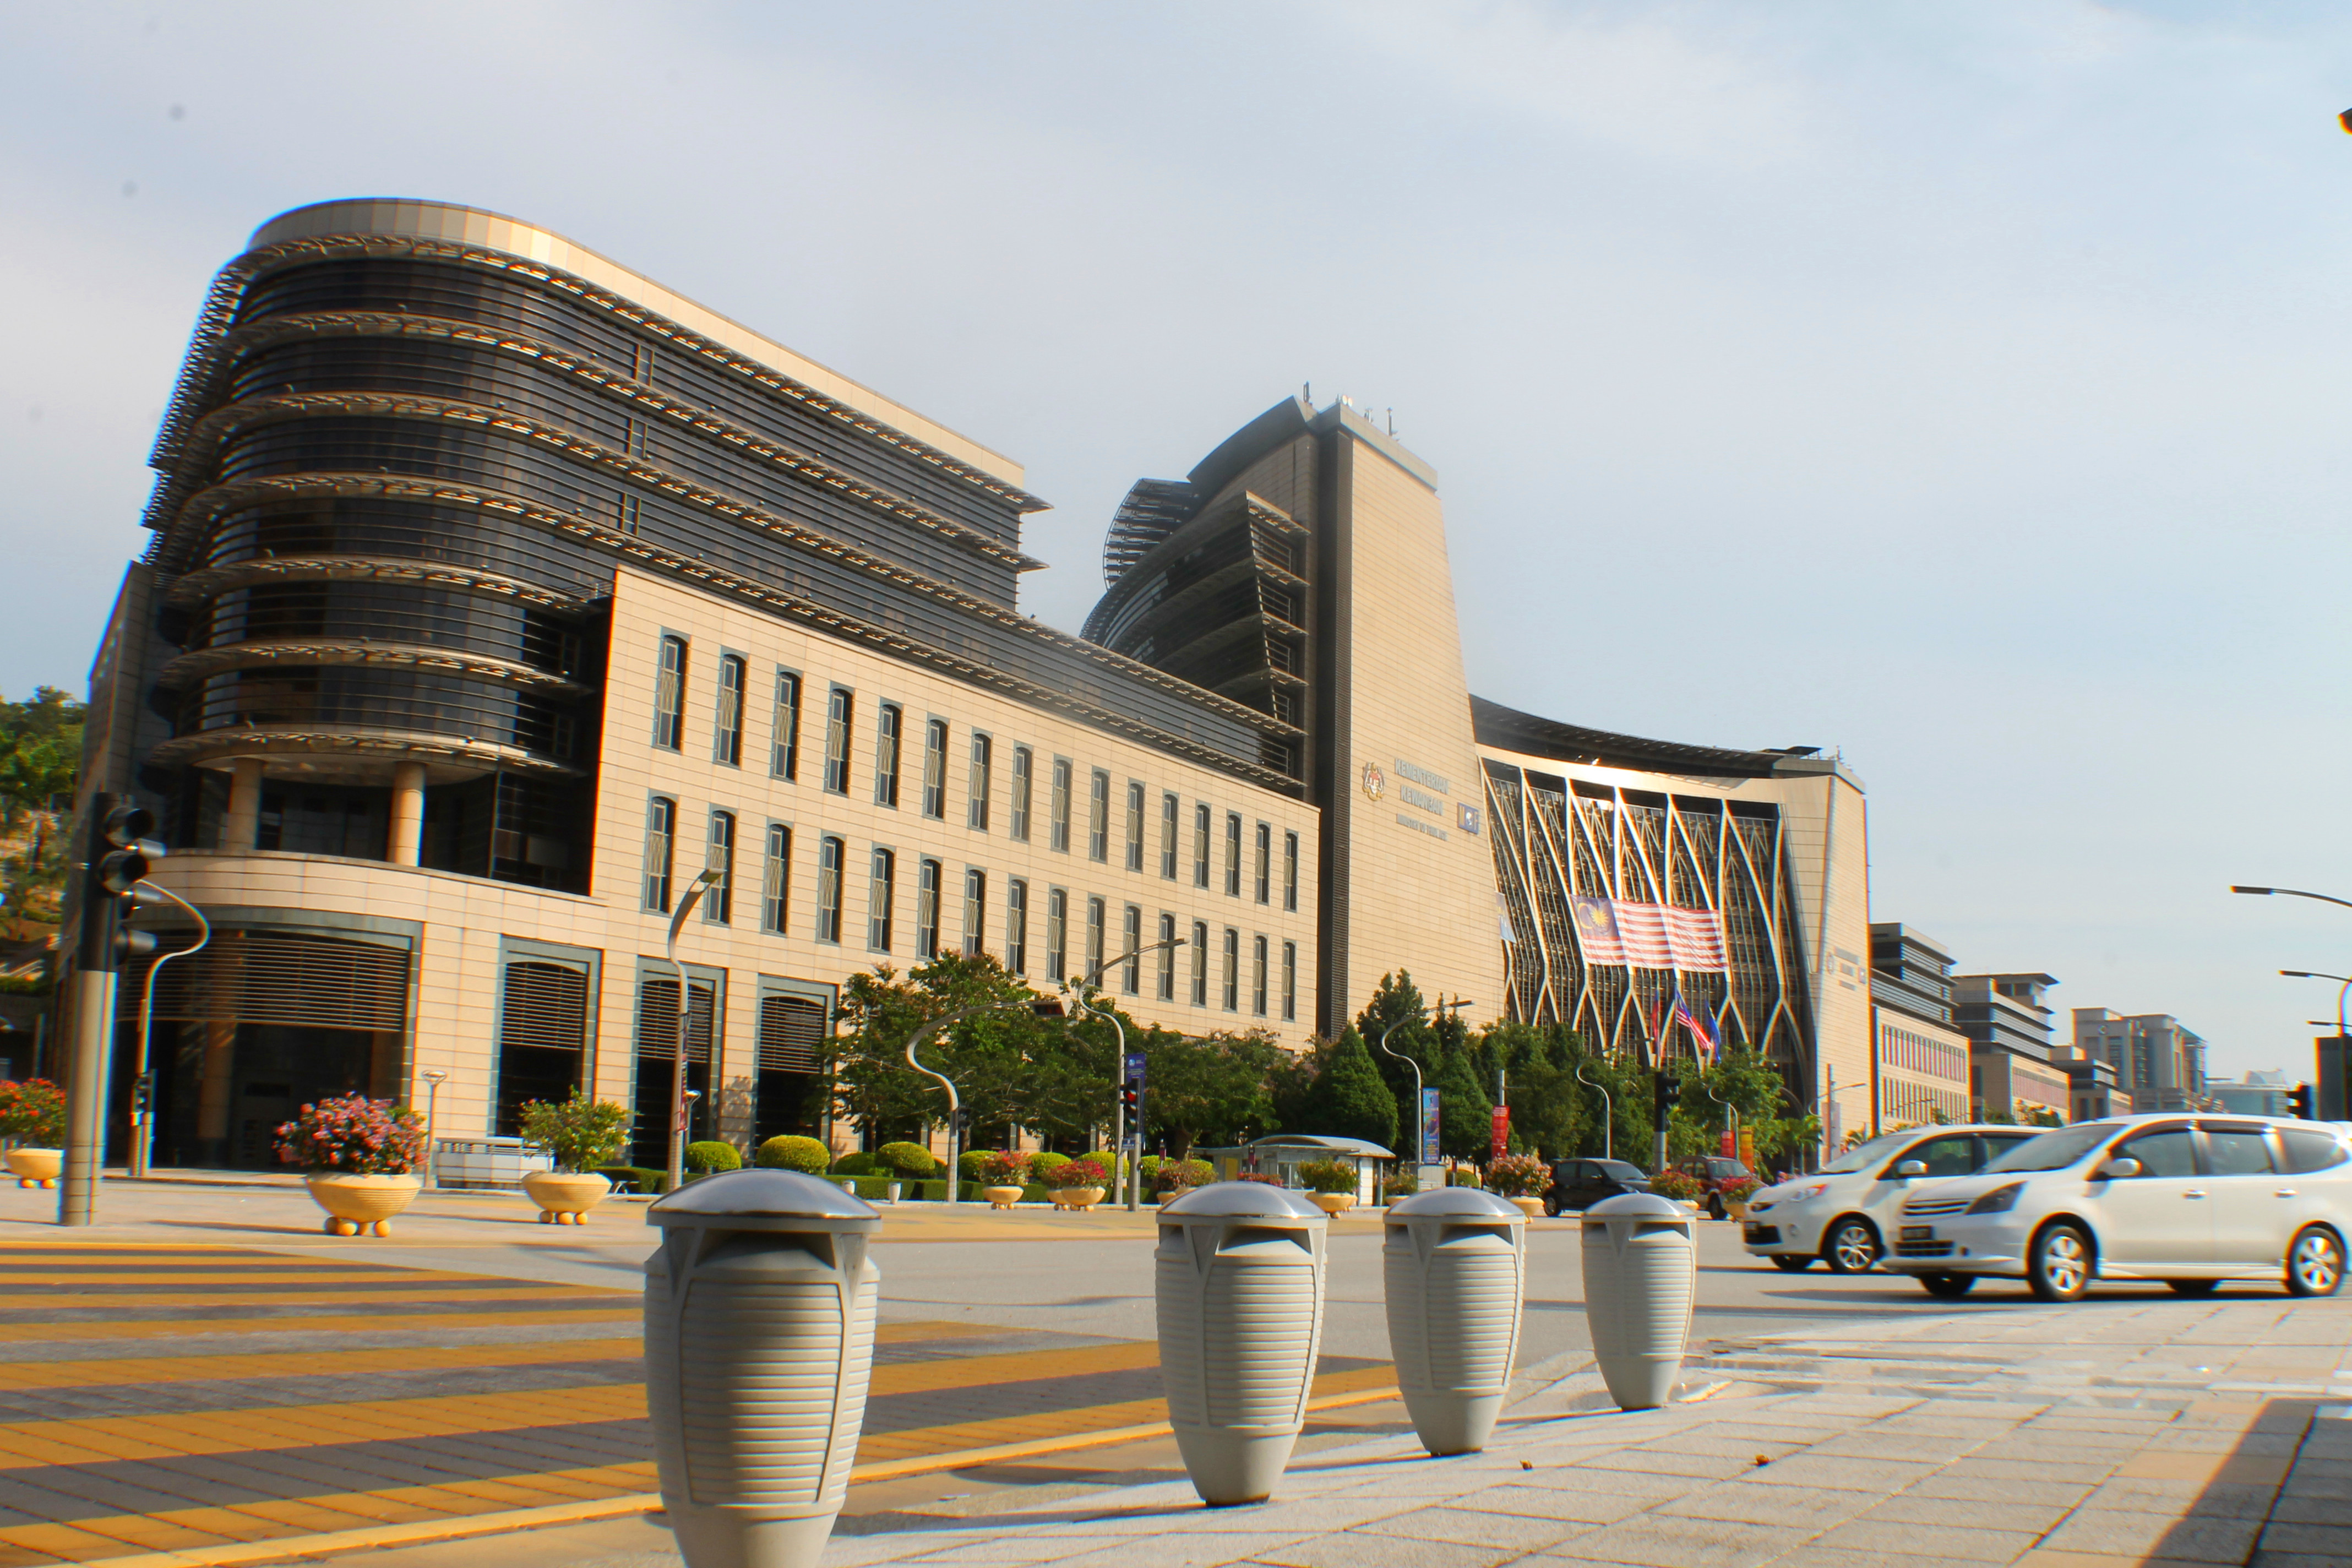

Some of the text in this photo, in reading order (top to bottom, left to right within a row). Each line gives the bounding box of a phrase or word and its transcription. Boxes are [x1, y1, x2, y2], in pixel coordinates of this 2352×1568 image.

[1395, 758, 1449, 795] KEMENTERIAN
[1400, 785, 1443, 816] KEWANGAN
[1396, 813, 1420, 830] ISTRY
[1427, 825, 1448, 841] FICE
